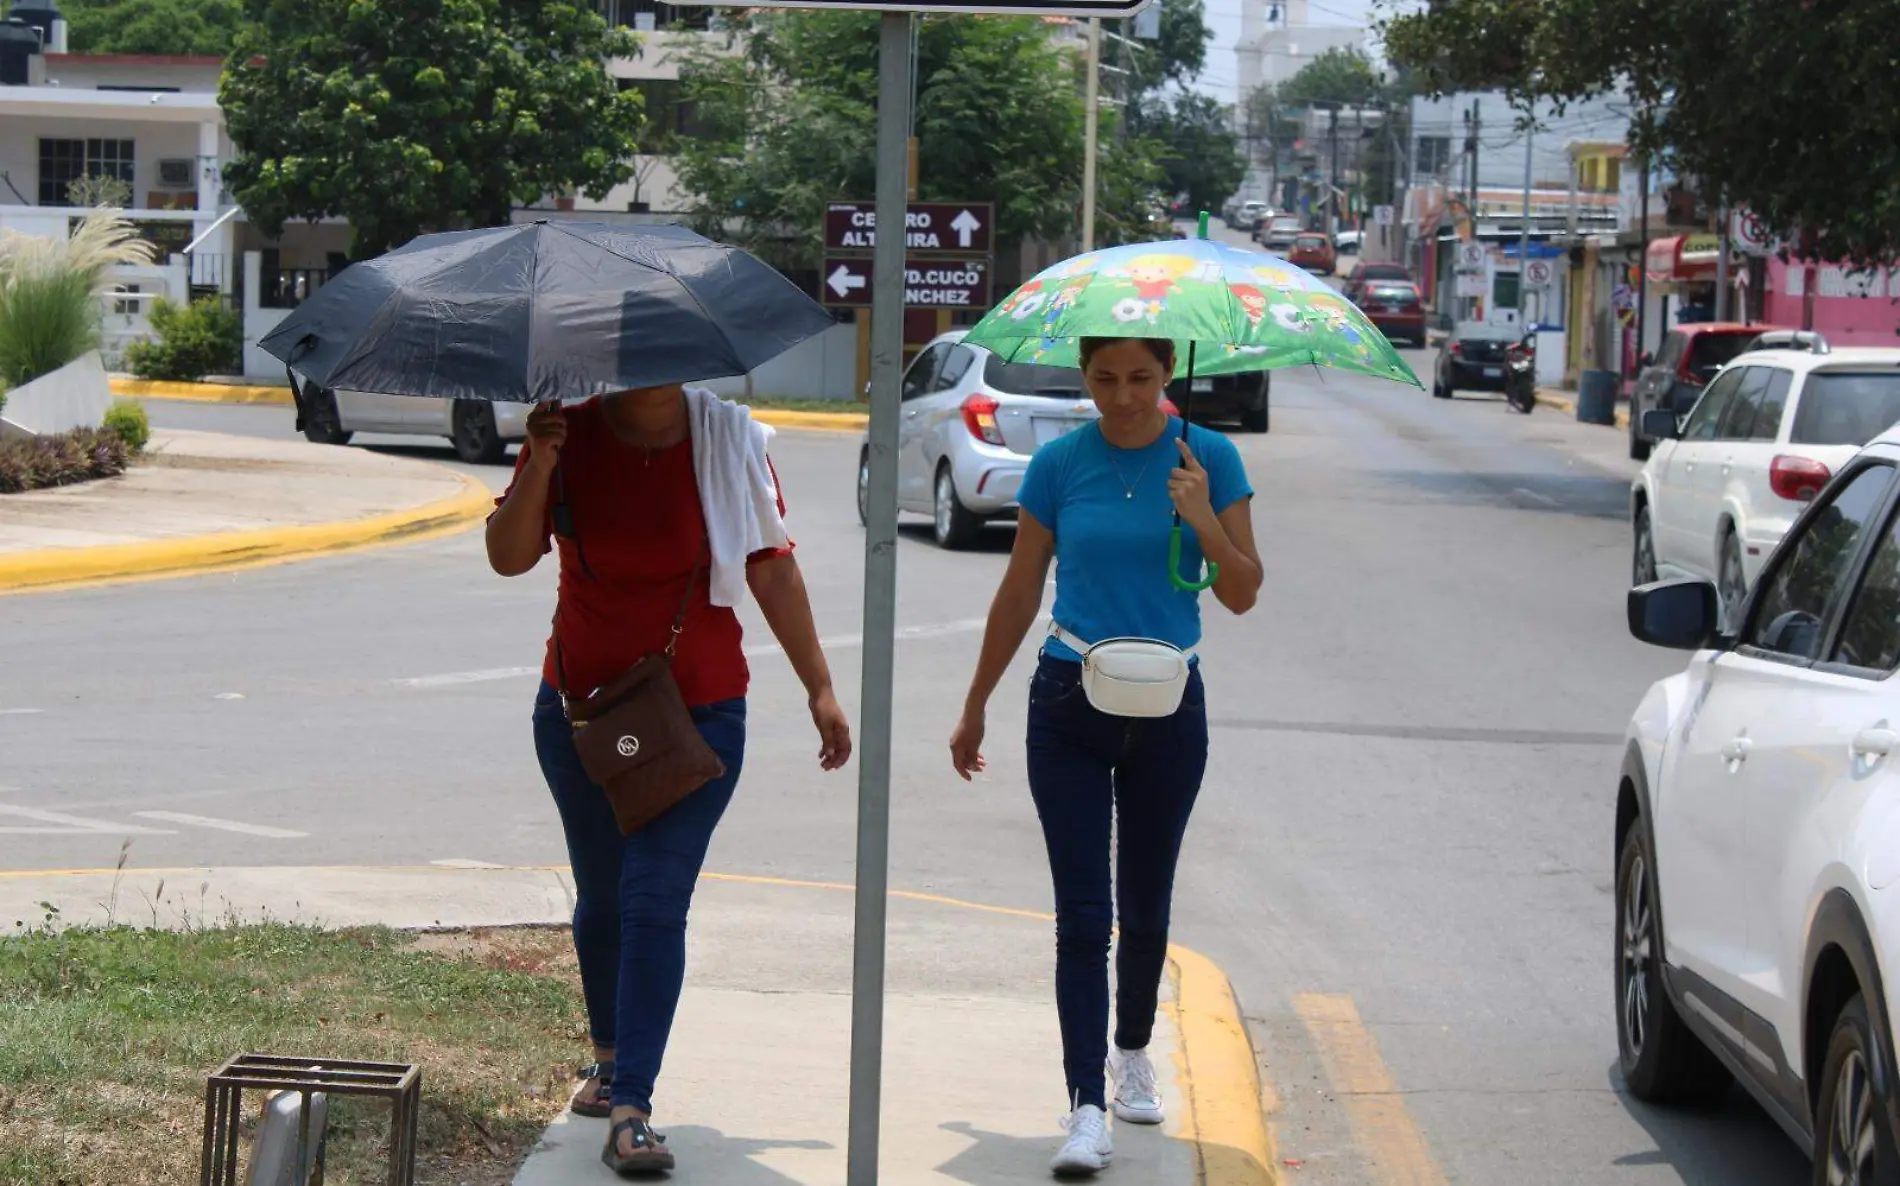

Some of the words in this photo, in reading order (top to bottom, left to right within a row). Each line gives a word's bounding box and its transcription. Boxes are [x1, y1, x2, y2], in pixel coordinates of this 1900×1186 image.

[851, 212, 931, 228] CERO
[841, 232, 940, 248] ALTIRA
[904, 269, 979, 285] D.CUCO
[905, 288, 970, 305] NCHEZ
